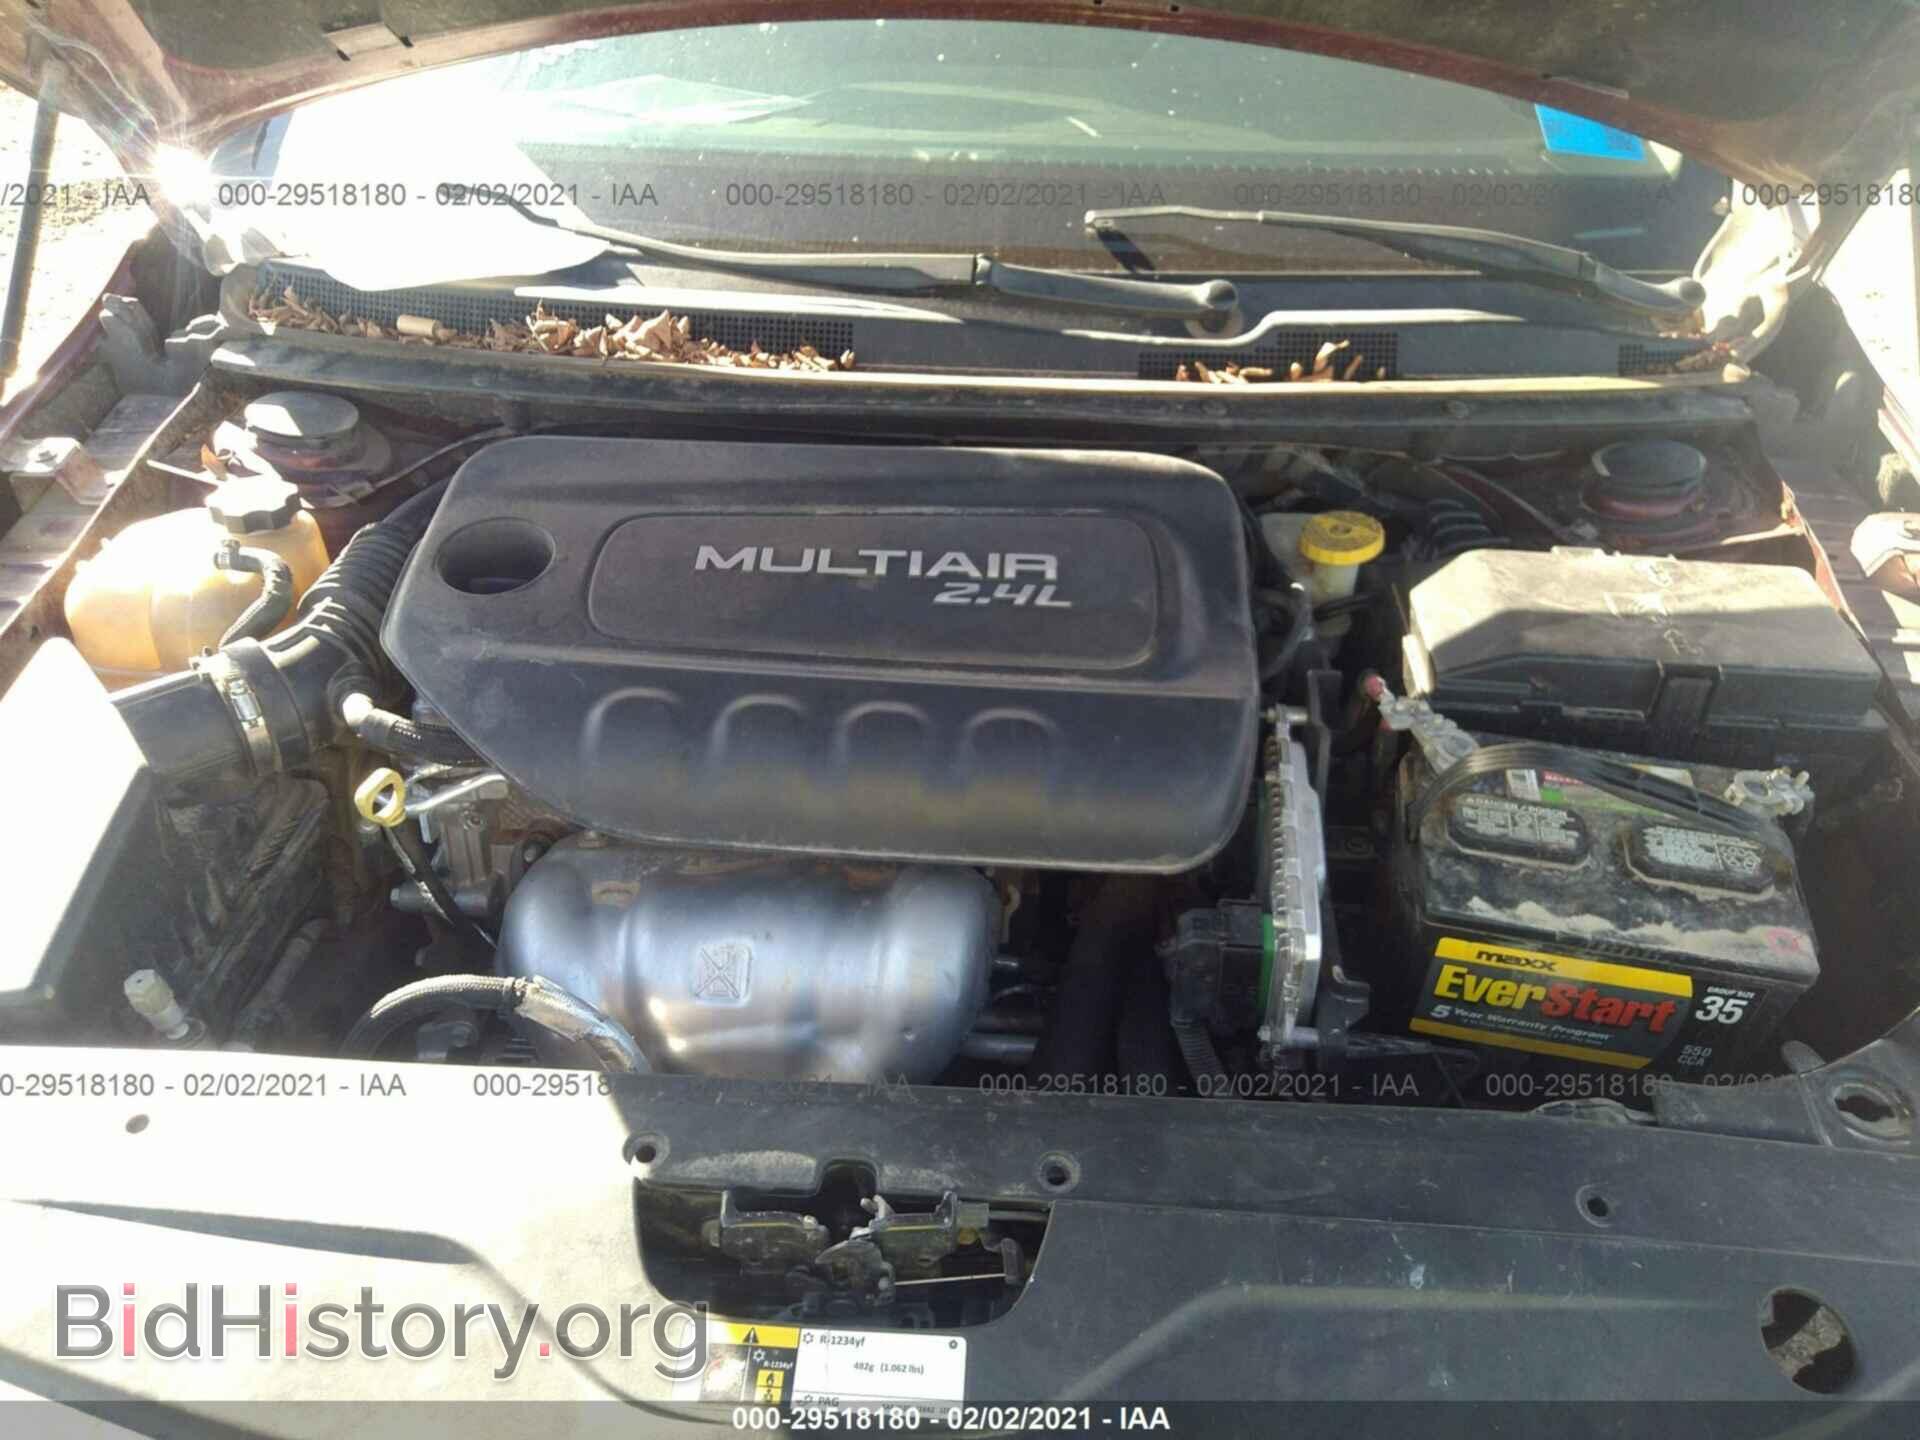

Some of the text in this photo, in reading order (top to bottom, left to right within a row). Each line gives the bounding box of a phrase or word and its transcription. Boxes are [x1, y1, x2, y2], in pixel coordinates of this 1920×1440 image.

[695, 545, 1058, 580] MULTIAIR
[933, 582, 1072, 608] 2.4L
[1475, 949, 1558, 973] maxx
[1433, 963, 1677, 1034] EverStart
[1695, 995, 1749, 1025] 35
[1430, 1004, 1452, 1019] 5
[1453, 1007, 1485, 1020] Year
[1486, 1012, 1551, 1032] Warranty
